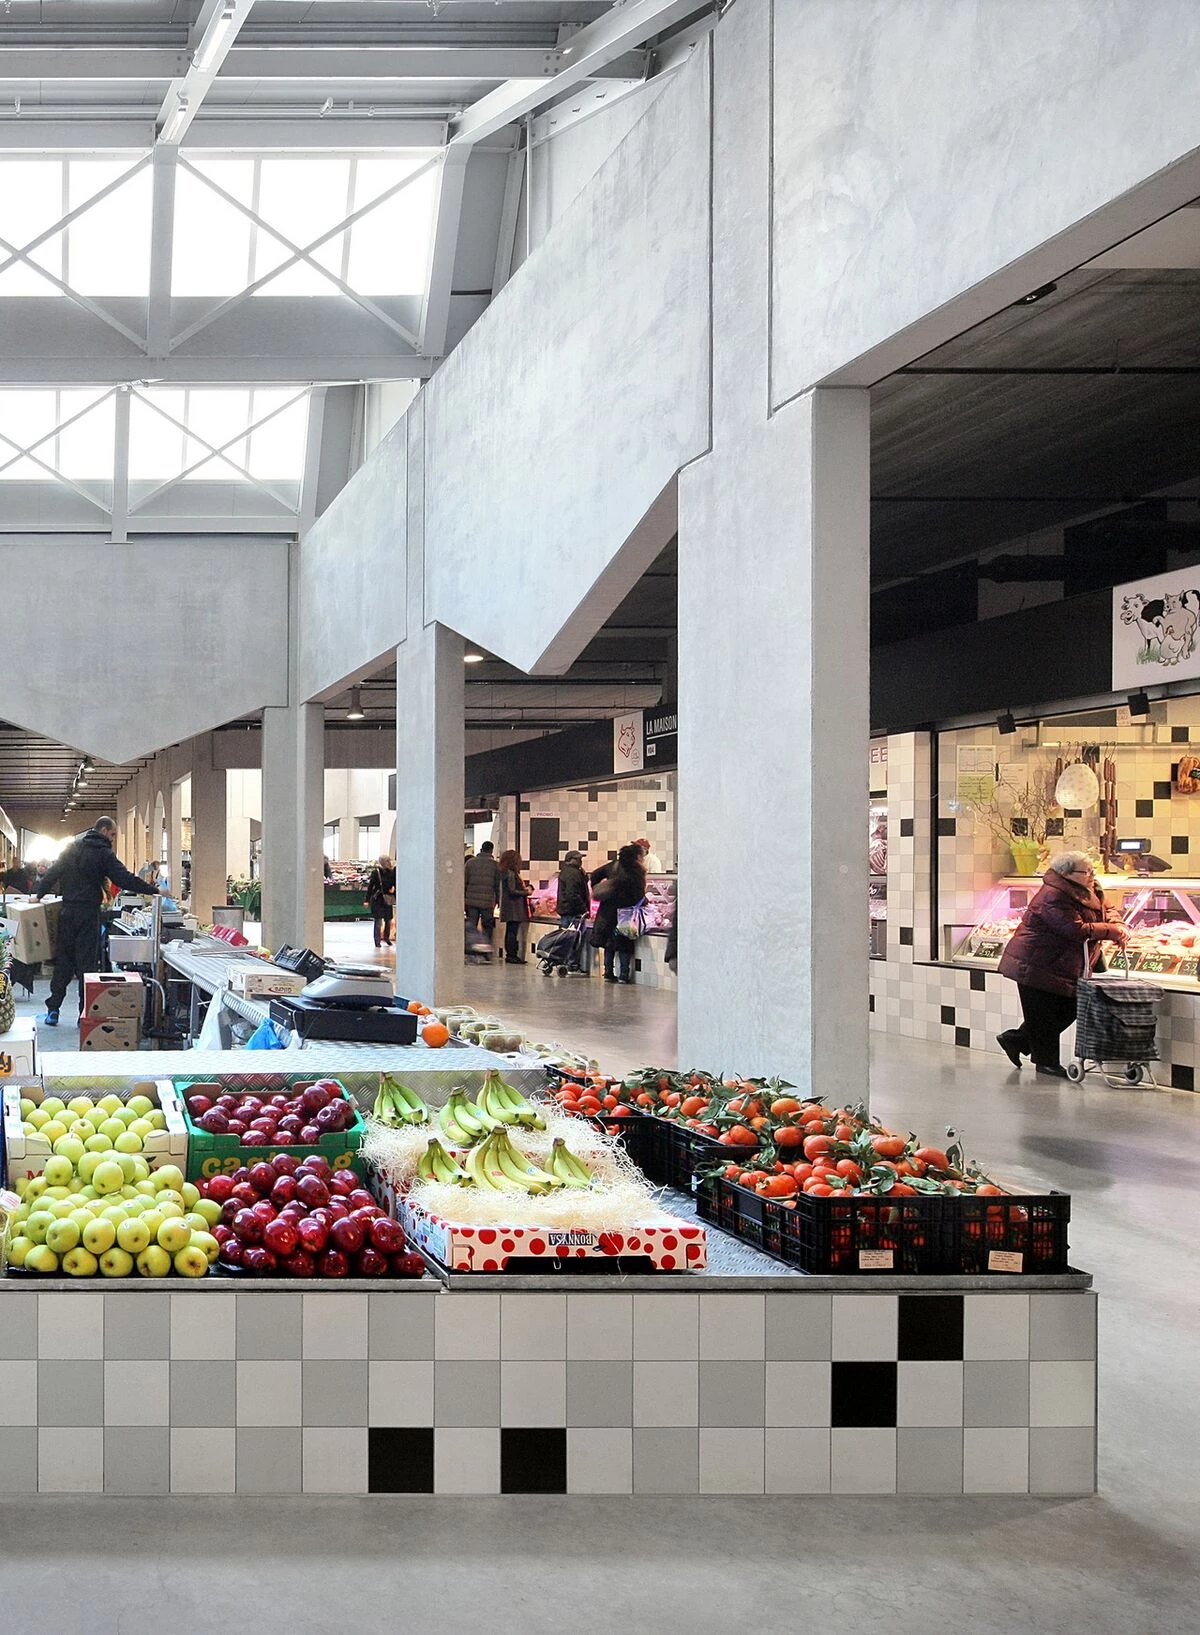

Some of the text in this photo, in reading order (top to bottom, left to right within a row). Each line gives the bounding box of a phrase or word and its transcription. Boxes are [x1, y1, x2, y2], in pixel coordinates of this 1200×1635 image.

[646, 715, 677, 735] LA MAISON
[549, 1233, 592, 1245] BONNYSA
